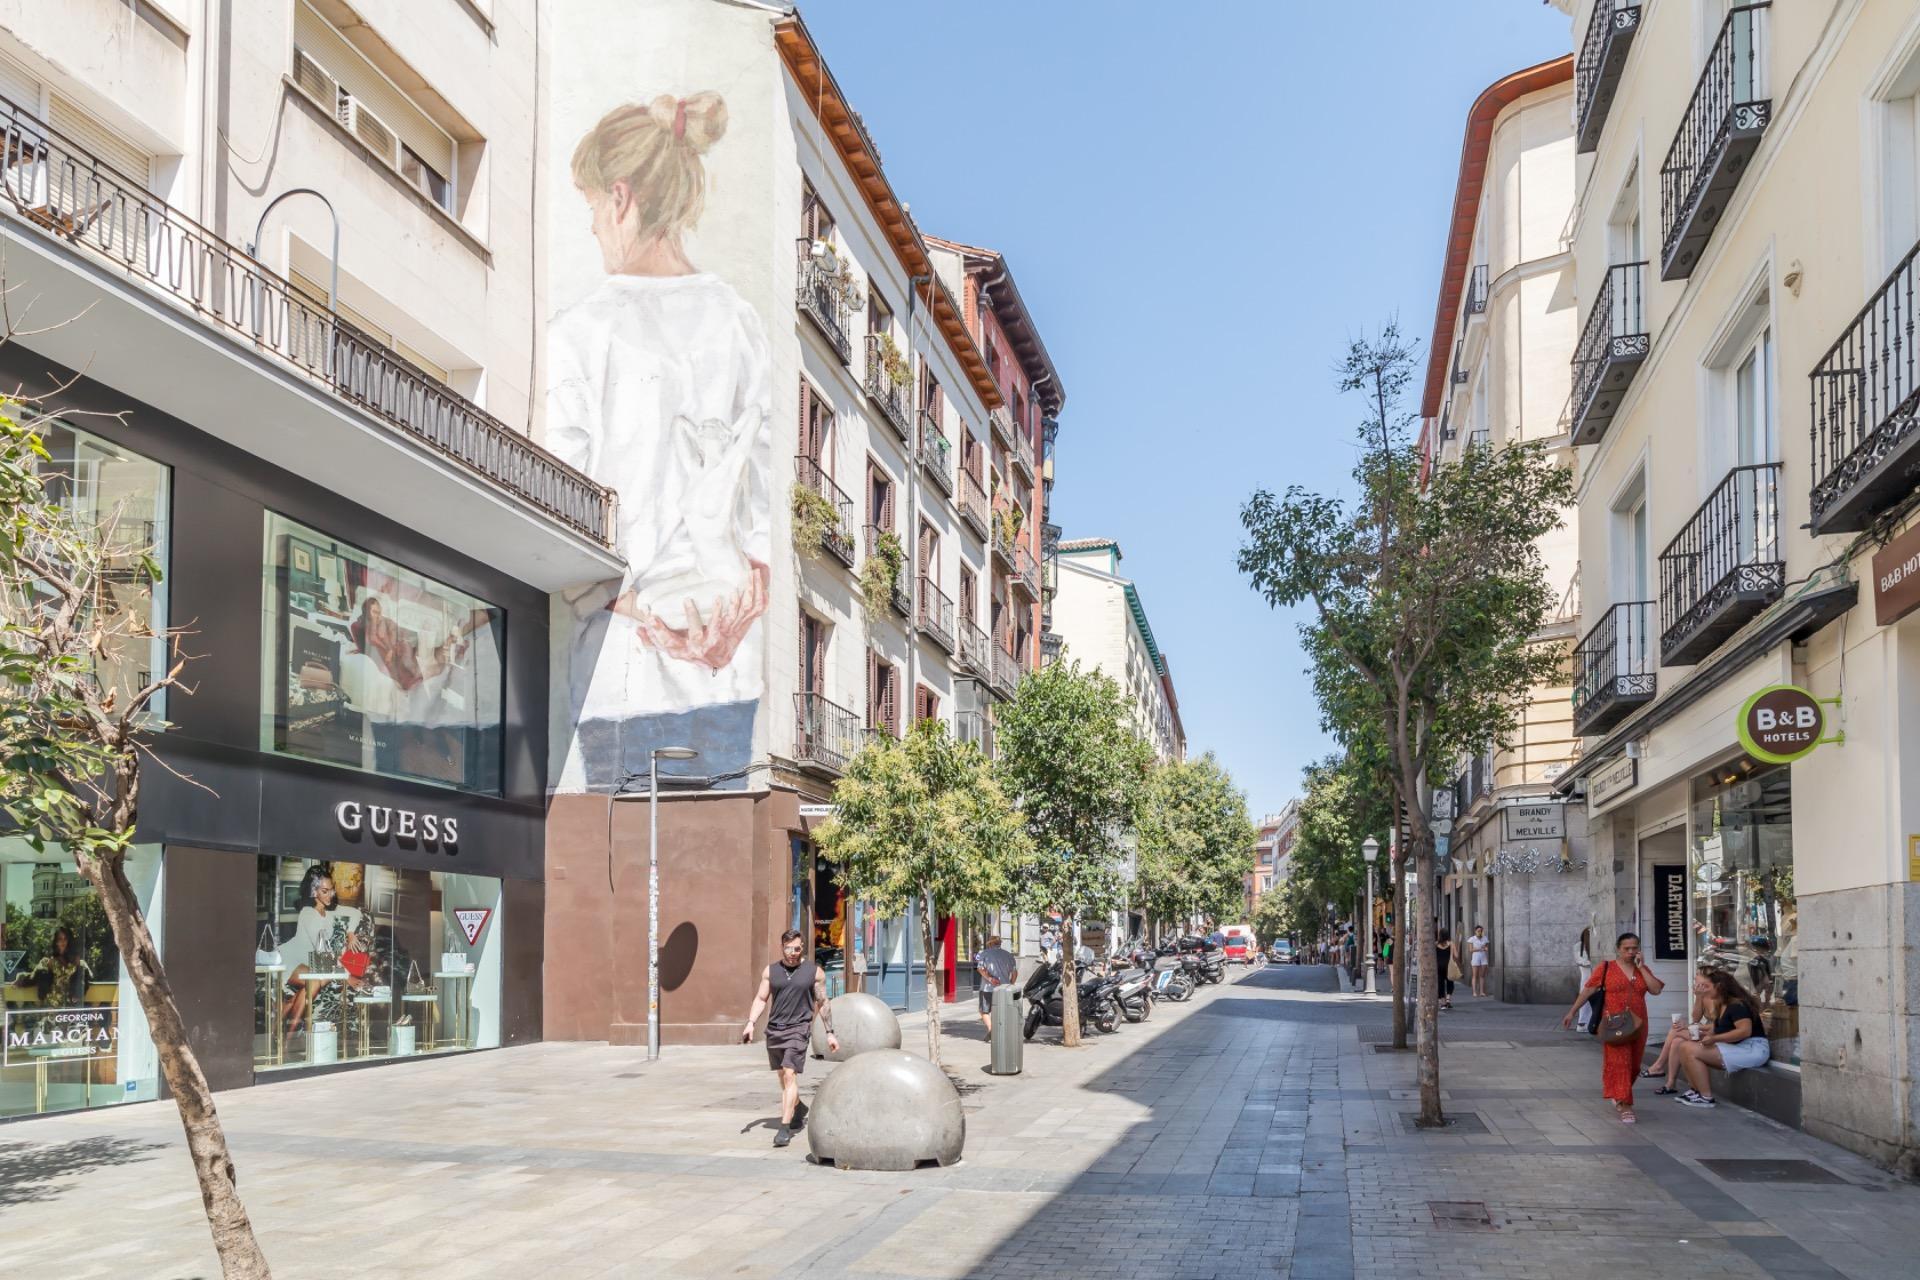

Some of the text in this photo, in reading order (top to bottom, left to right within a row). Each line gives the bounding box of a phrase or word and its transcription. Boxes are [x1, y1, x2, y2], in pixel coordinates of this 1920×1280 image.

[1880, 567, 1901, 593] B&B
[1757, 706, 1816, 730] B&B
[1763, 731, 1810, 743] HOTELS
[1519, 807, 1552, 817] BRANDY
[335, 800, 458, 843] GUESS
[1515, 825, 1557, 836] MELVILLE
[459, 912, 483, 921] GUESS
[1668, 874, 1685, 951] DARTMOUTH
[55, 1012, 104, 1023] GEORGINA
